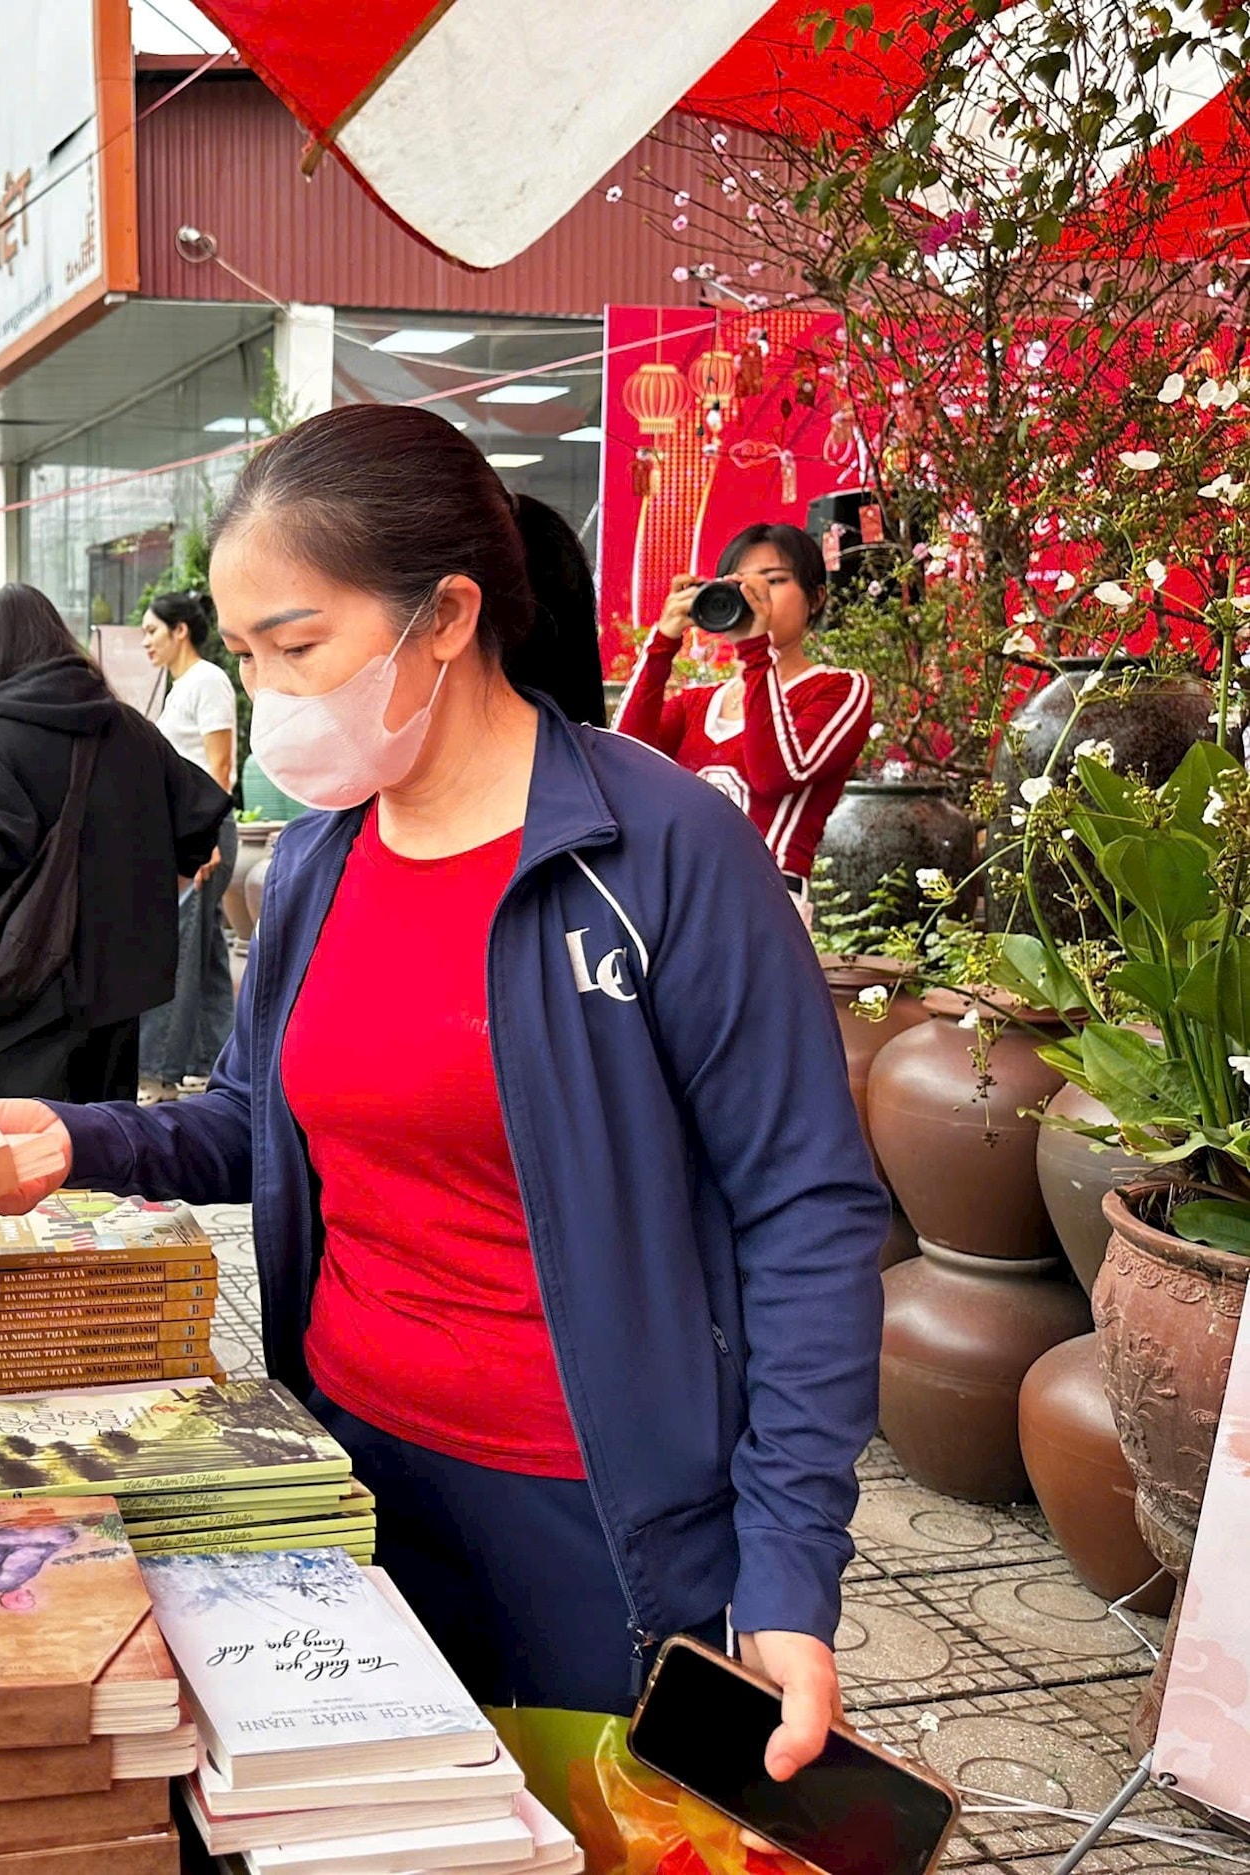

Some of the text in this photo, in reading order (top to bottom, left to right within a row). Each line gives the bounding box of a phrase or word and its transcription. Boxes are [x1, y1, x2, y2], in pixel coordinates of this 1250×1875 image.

[52, 1270, 70, 1280] TỰA
[74, 1269, 85, 1278] VÀ
[138, 1264, 162, 1273] HÀNH
[52, 1290, 71, 1299] TỰA
[74, 1288, 86, 1297] VÀ
[139, 1284, 163, 1293] HÀNH
[50, 1310, 68, 1318] TỰA
[71, 1308, 82, 1316] VÀ
[136, 1303, 160, 1312] HÀNH
[45, 1330, 64, 1338] TỰA
[67, 1328, 78, 1336] VÀ
[132, 1324, 156, 1333] HÀNH
[44, 1350, 62, 1358] TỰA
[65, 1348, 76, 1356] VÀ
[130, 1342, 154, 1351] HÀNH
[265, 1629, 300, 1650] gia
[302, 1628, 352, 1657] trong
[312, 1711, 367, 1726] NHẤT
[380, 1704, 452, 1720] THÍCH
[238, 1717, 296, 1733] HẠNH
